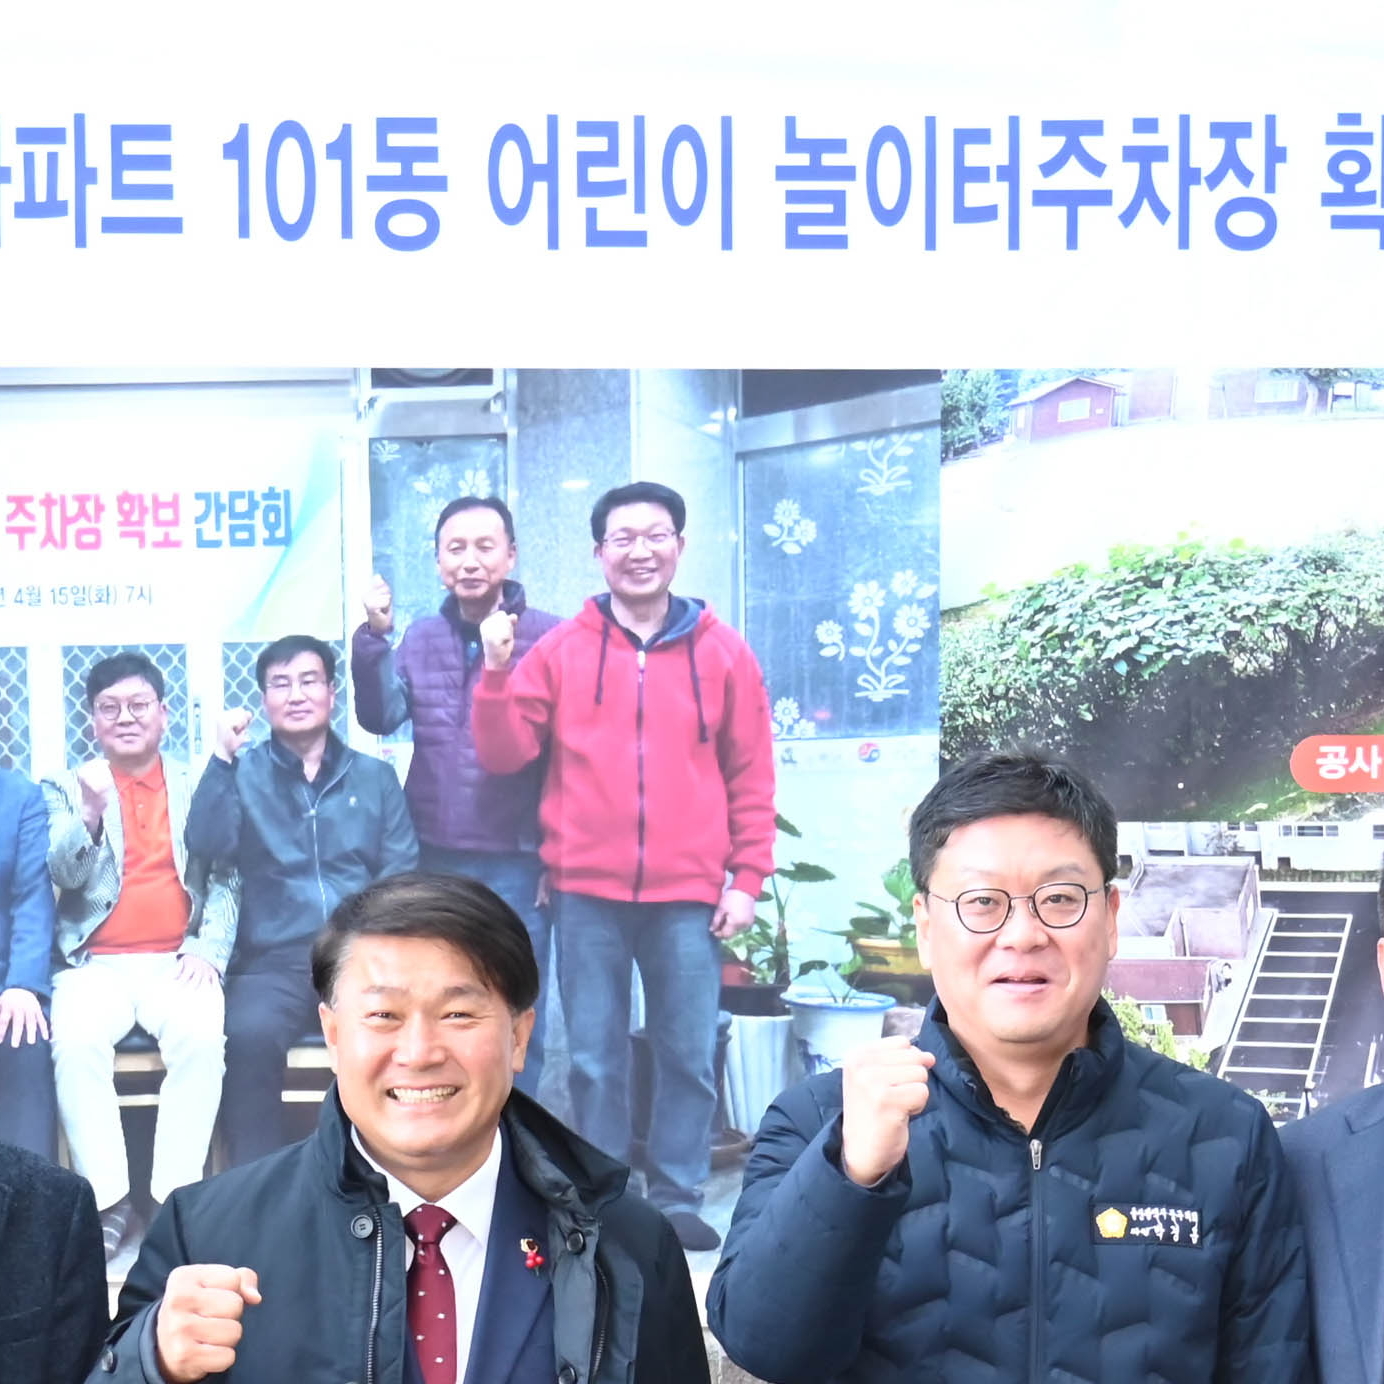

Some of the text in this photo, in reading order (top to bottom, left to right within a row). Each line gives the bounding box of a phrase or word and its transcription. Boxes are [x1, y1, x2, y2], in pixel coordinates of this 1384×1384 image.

[222, 116, 449, 252] 101동
[488, 114, 734, 252] 어린이
[774, 113, 1288, 252] 놀이터주차장
[5, 492, 106, 551] 주차장
[117, 490, 183, 550] 확보
[194, 485, 293, 549] 간담회
[13, 585, 42, 607] 4월
[50, 584, 118, 607] 15일(화)
[125, 585, 153, 606] 7시
[1316, 744, 1382, 779] 공사
